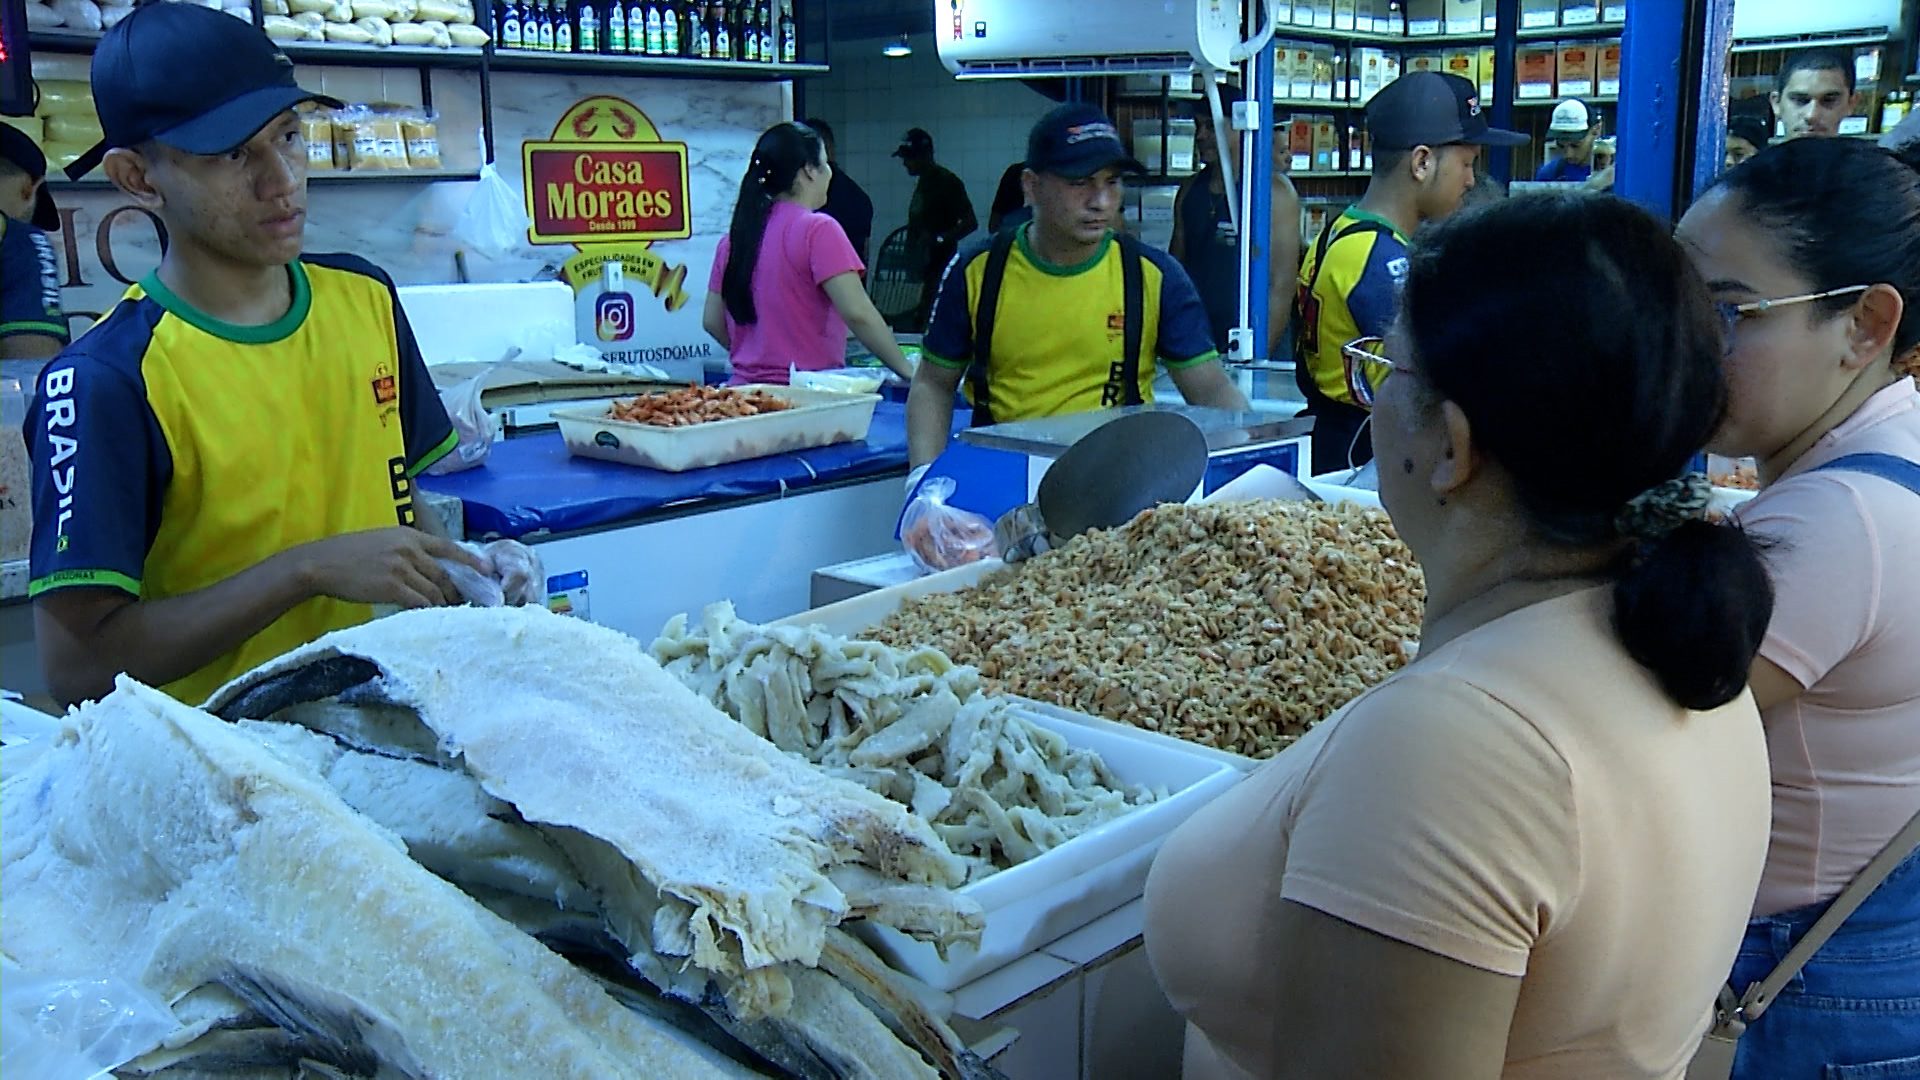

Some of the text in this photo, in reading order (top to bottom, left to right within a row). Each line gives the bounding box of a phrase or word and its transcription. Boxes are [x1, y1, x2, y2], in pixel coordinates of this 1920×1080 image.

[575, 153, 644, 185] Casa
[547, 182, 672, 220] Moraes
[589, 219, 636, 231] Desde 1999
[574, 253, 654, 273] ESPECIALIDADES EM
[630, 265, 647, 275] MAR
[46, 367, 78, 536] BRASIL
